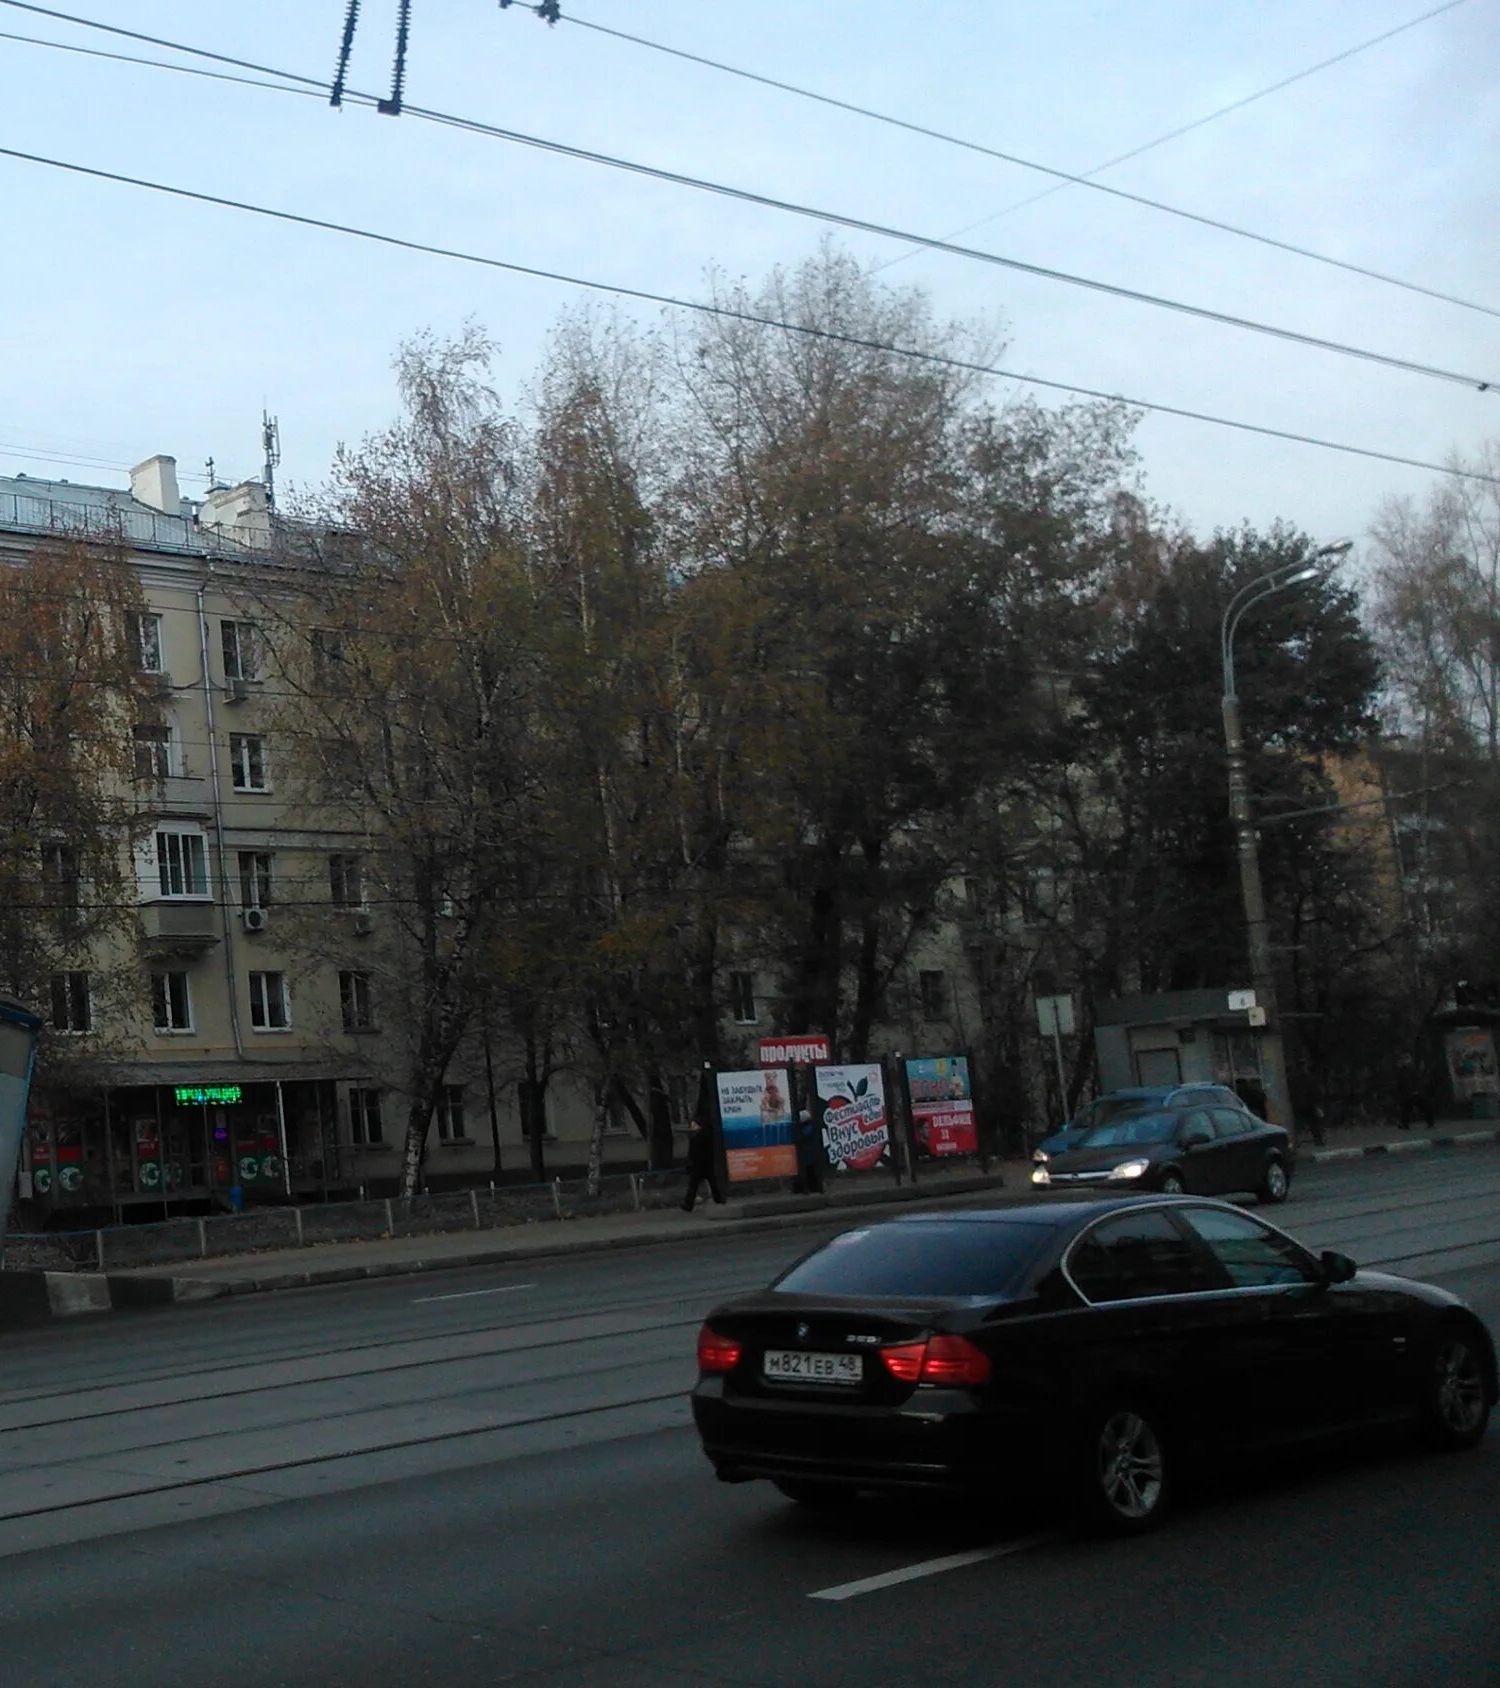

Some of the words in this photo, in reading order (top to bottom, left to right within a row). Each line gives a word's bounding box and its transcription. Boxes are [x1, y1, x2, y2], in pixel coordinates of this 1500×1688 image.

[760, 1043, 828, 1063] ПРОДУКТЫ
[830, 1122, 858, 1143] Вкус
[829, 1130, 886, 1162] здоровья
